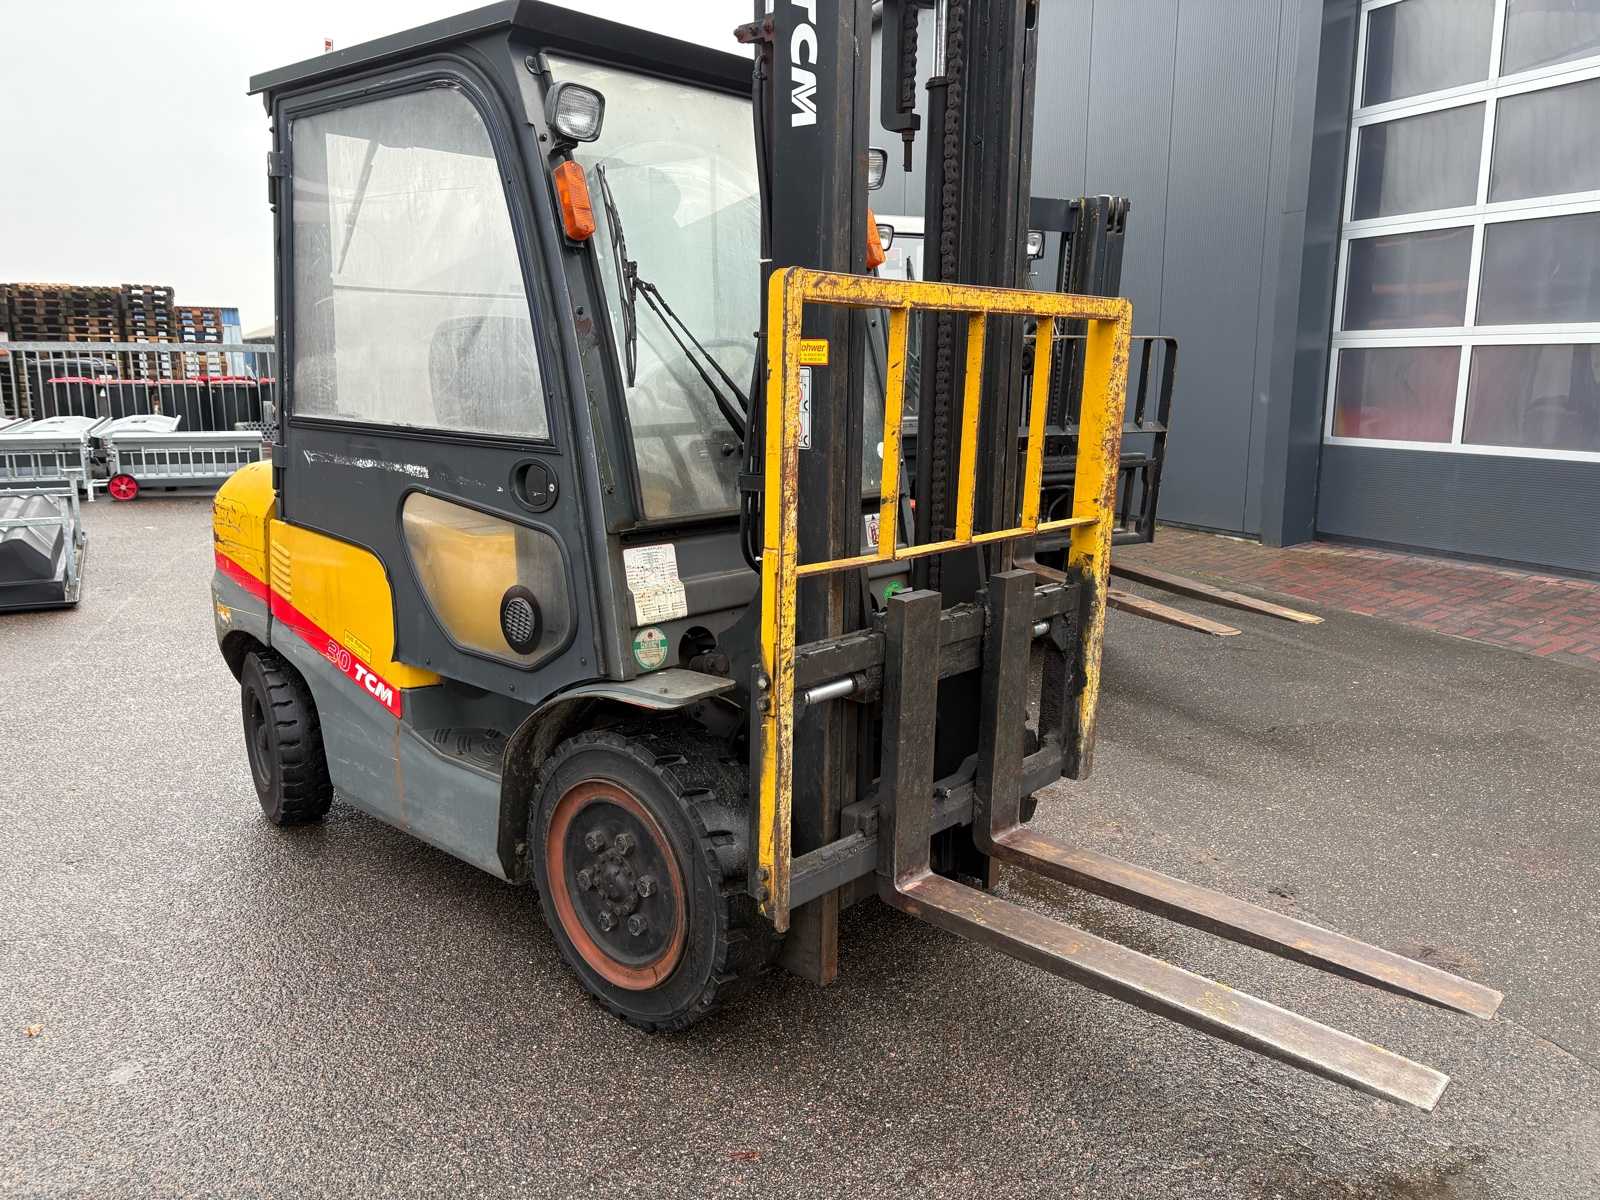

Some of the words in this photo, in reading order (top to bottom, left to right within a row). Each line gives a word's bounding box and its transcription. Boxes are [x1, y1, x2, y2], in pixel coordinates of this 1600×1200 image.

[800, 343, 826, 352] ohwer
[326, 639, 351, 672] 30
[355, 663, 393, 707] TCM
